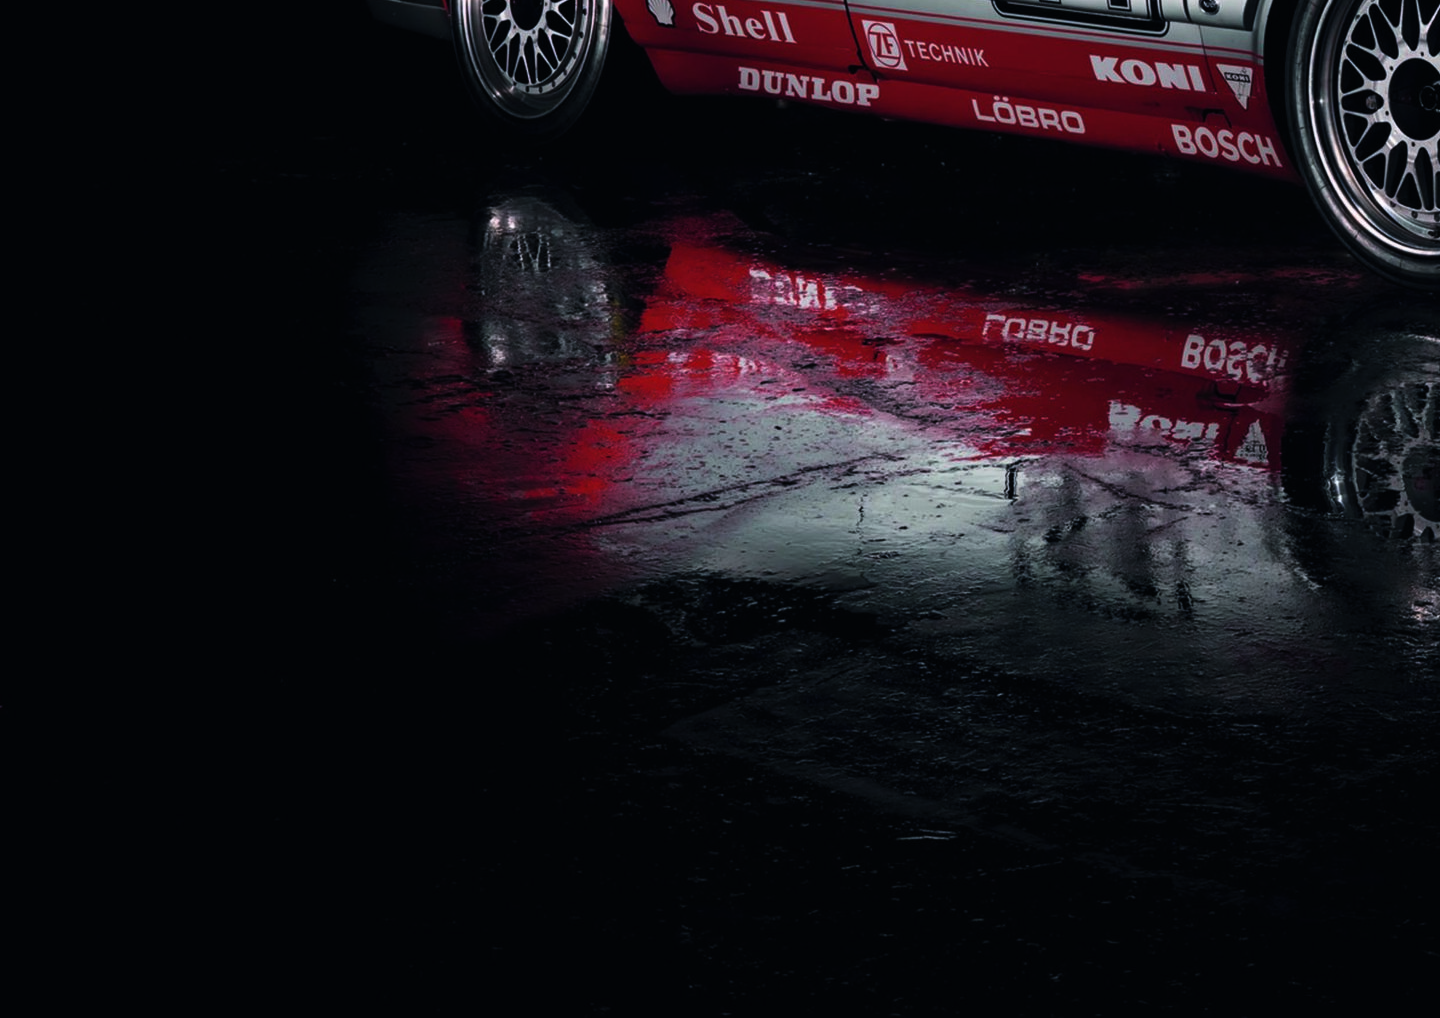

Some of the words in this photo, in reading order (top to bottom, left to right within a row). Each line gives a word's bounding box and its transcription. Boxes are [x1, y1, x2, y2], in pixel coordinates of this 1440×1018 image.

[692, 2, 798, 44] Shell
[904, 39, 990, 68] TECHNIK
[1089, 54, 1207, 93] KONI
[737, 66, 881, 106] DUNLOP
[971, 95, 1086, 135] LÖBRO
[1170, 124, 1283, 168] BOSCH
